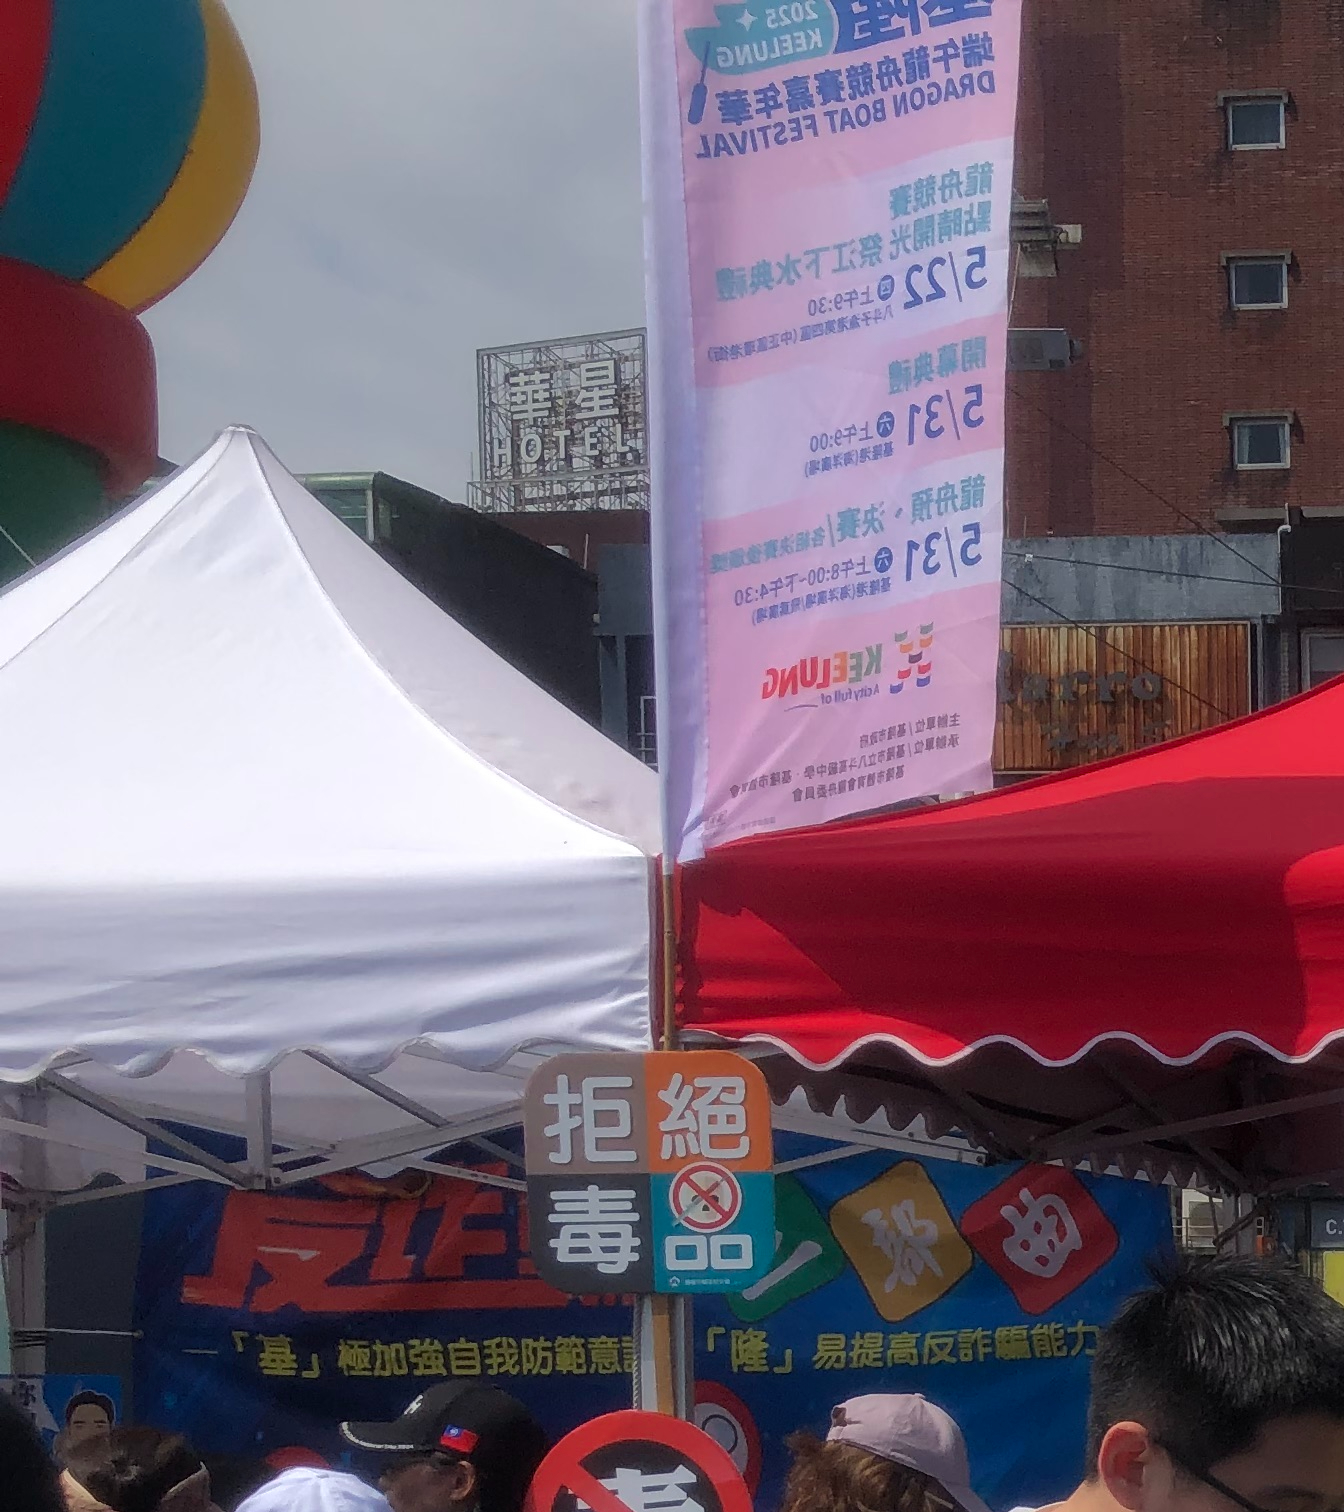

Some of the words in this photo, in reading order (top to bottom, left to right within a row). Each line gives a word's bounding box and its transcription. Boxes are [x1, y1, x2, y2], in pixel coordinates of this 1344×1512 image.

[509, 358, 620, 425] 華星
[493, 423, 630, 468] HOTEL
[544, 1072, 750, 1165] 拒絕
[547, 1166, 754, 1275] 毒品
